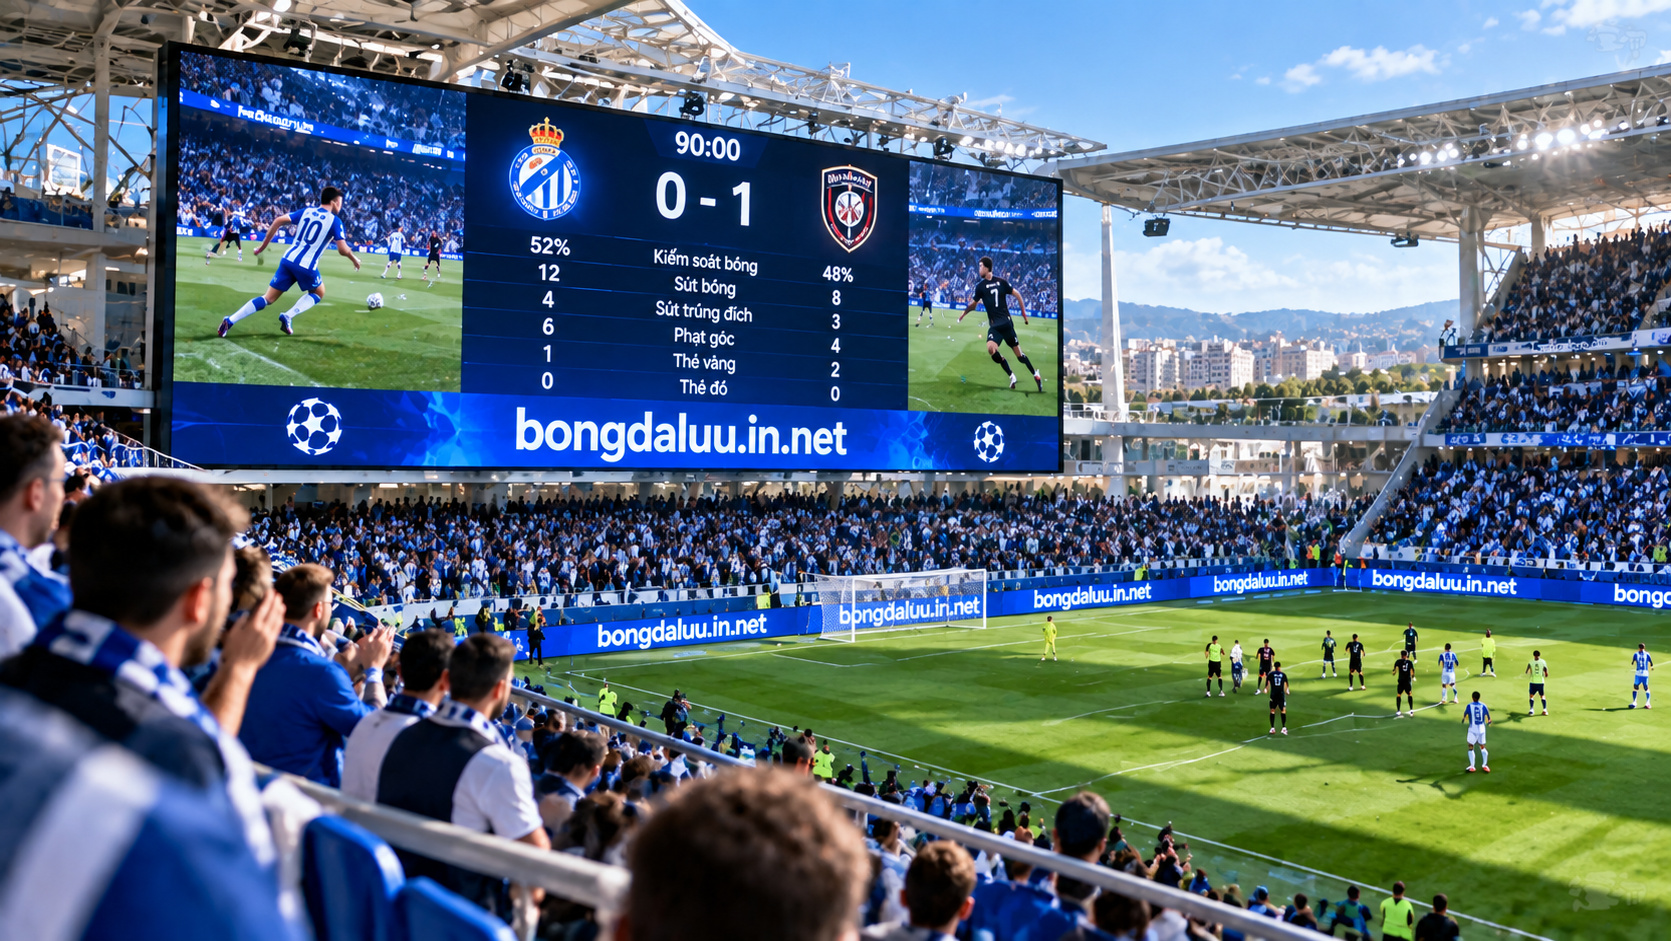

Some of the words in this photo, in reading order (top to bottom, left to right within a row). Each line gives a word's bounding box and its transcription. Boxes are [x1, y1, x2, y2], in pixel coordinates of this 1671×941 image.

[675, 130, 740, 161] 90:00
[656, 171, 686, 219] 0
[700, 197, 716, 207] -
[732, 181, 750, 227] 1
[296, 217, 323, 245] 10
[530, 235, 571, 256] 52%
[538, 263, 560, 282] 12
[692, 253, 722, 270] soát
[724, 255, 758, 277] bóng
[822, 265, 854, 283] 48%
[674, 275, 698, 293] Sút
[701, 277, 736, 299] bóng
[831, 289, 841, 306] 8
[990, 288, 999, 308] 7
[542, 290, 555, 308] 4
[655, 300, 680, 317] Sút
[682, 302, 720, 324] trúng
[723, 305, 753, 323] đích
[831, 313, 841, 330] 3
[542, 317, 555, 336] 6
[674, 326, 707, 347] Phạt
[709, 330, 735, 349] góc
[543, 344, 551, 363] 1
[830, 337, 841, 354] 4
[541, 371, 554, 390] 0
[830, 361, 841, 378] 2
[830, 385, 841, 402] 0
[515, 406, 848, 463] bongdaluu.in.net
[1213, 570, 1309, 595] bongdaluu.in.net
[1372, 569, 1518, 595] bongdaluu.in.net
[1033, 582, 1153, 611] bongdaluu.in.net
[839, 596, 981, 627] bongdaluu.in.net
[597, 612, 768, 650] bongdaluu.in.net
